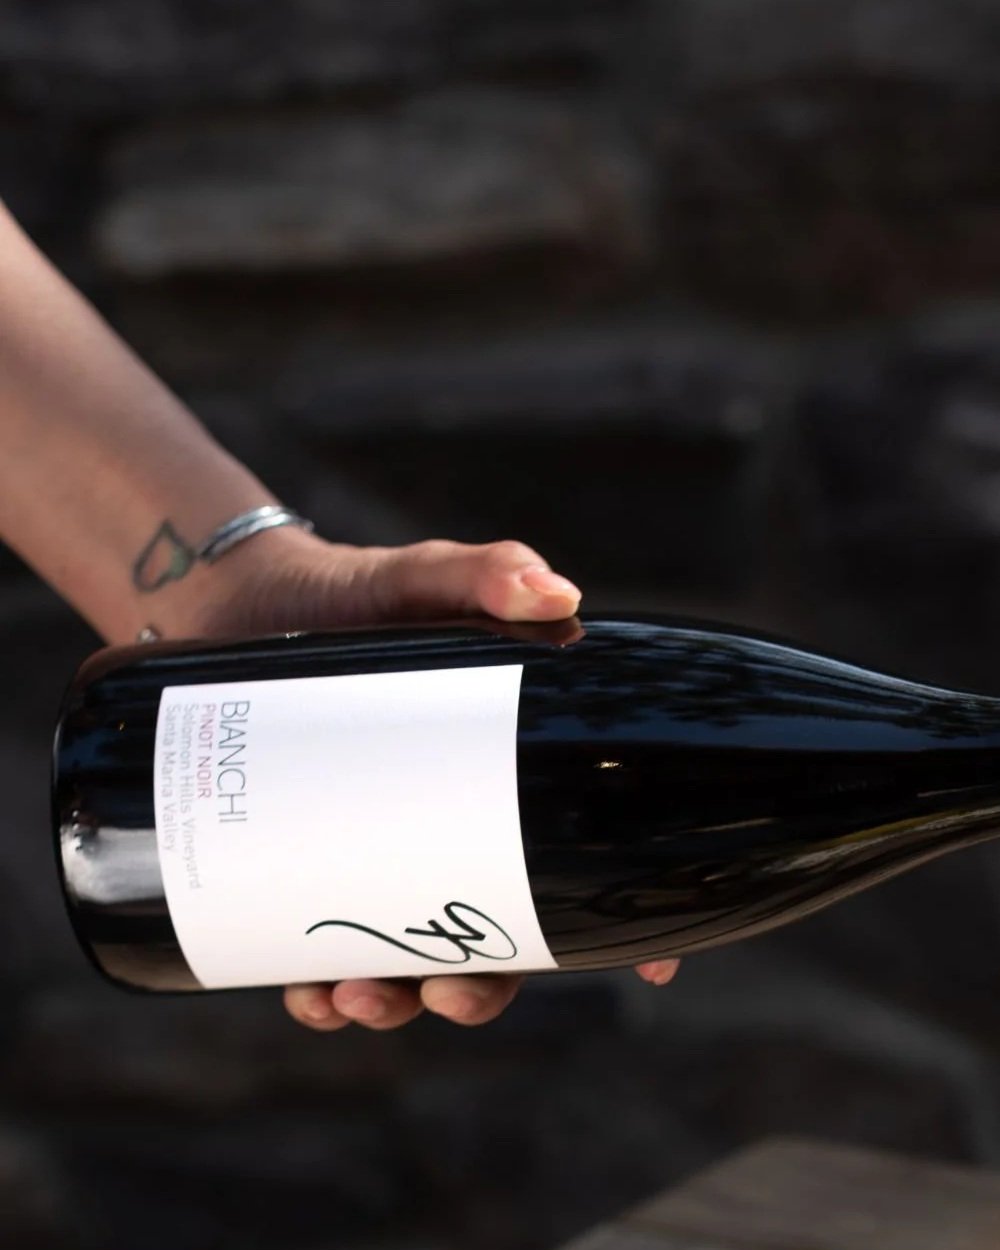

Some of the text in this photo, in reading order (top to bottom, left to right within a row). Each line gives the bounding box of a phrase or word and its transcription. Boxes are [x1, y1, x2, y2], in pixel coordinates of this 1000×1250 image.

[161, 705, 180, 852] Santa Maria Valley
[180, 704, 202, 889] Solomon Hills Vineyard
[197, 704, 216, 799] PINOT NOIR
[217, 702, 250, 823] BIANCHI
